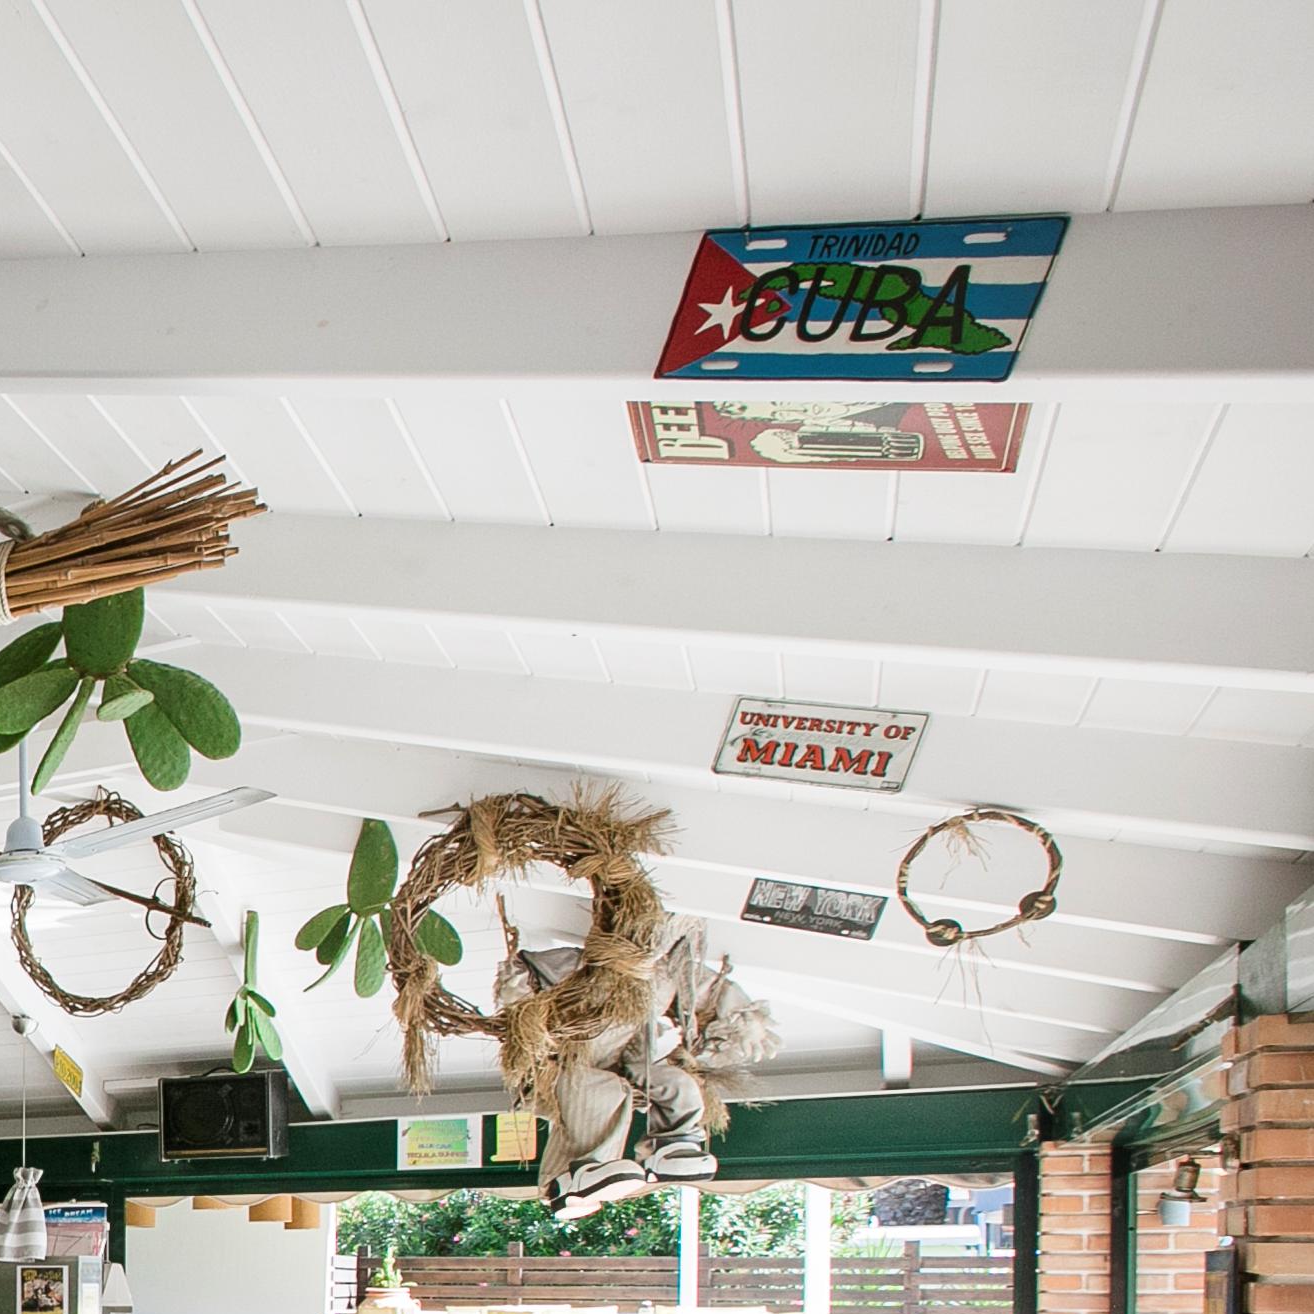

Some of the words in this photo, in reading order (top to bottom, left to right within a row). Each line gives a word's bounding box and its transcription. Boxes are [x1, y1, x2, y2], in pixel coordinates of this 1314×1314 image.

[808, 231, 920, 260] TRINIDAD
[738, 264, 972, 345] CUBA
[738, 711, 878, 739] UNIVERSITY
[883, 725, 916, 741] OF
[736, 738, 893, 777] MIAMI
[749, 880, 812, 912] NEW
[814, 889, 884, 923] YORK
[48, 1208, 62, 1216] ICE
